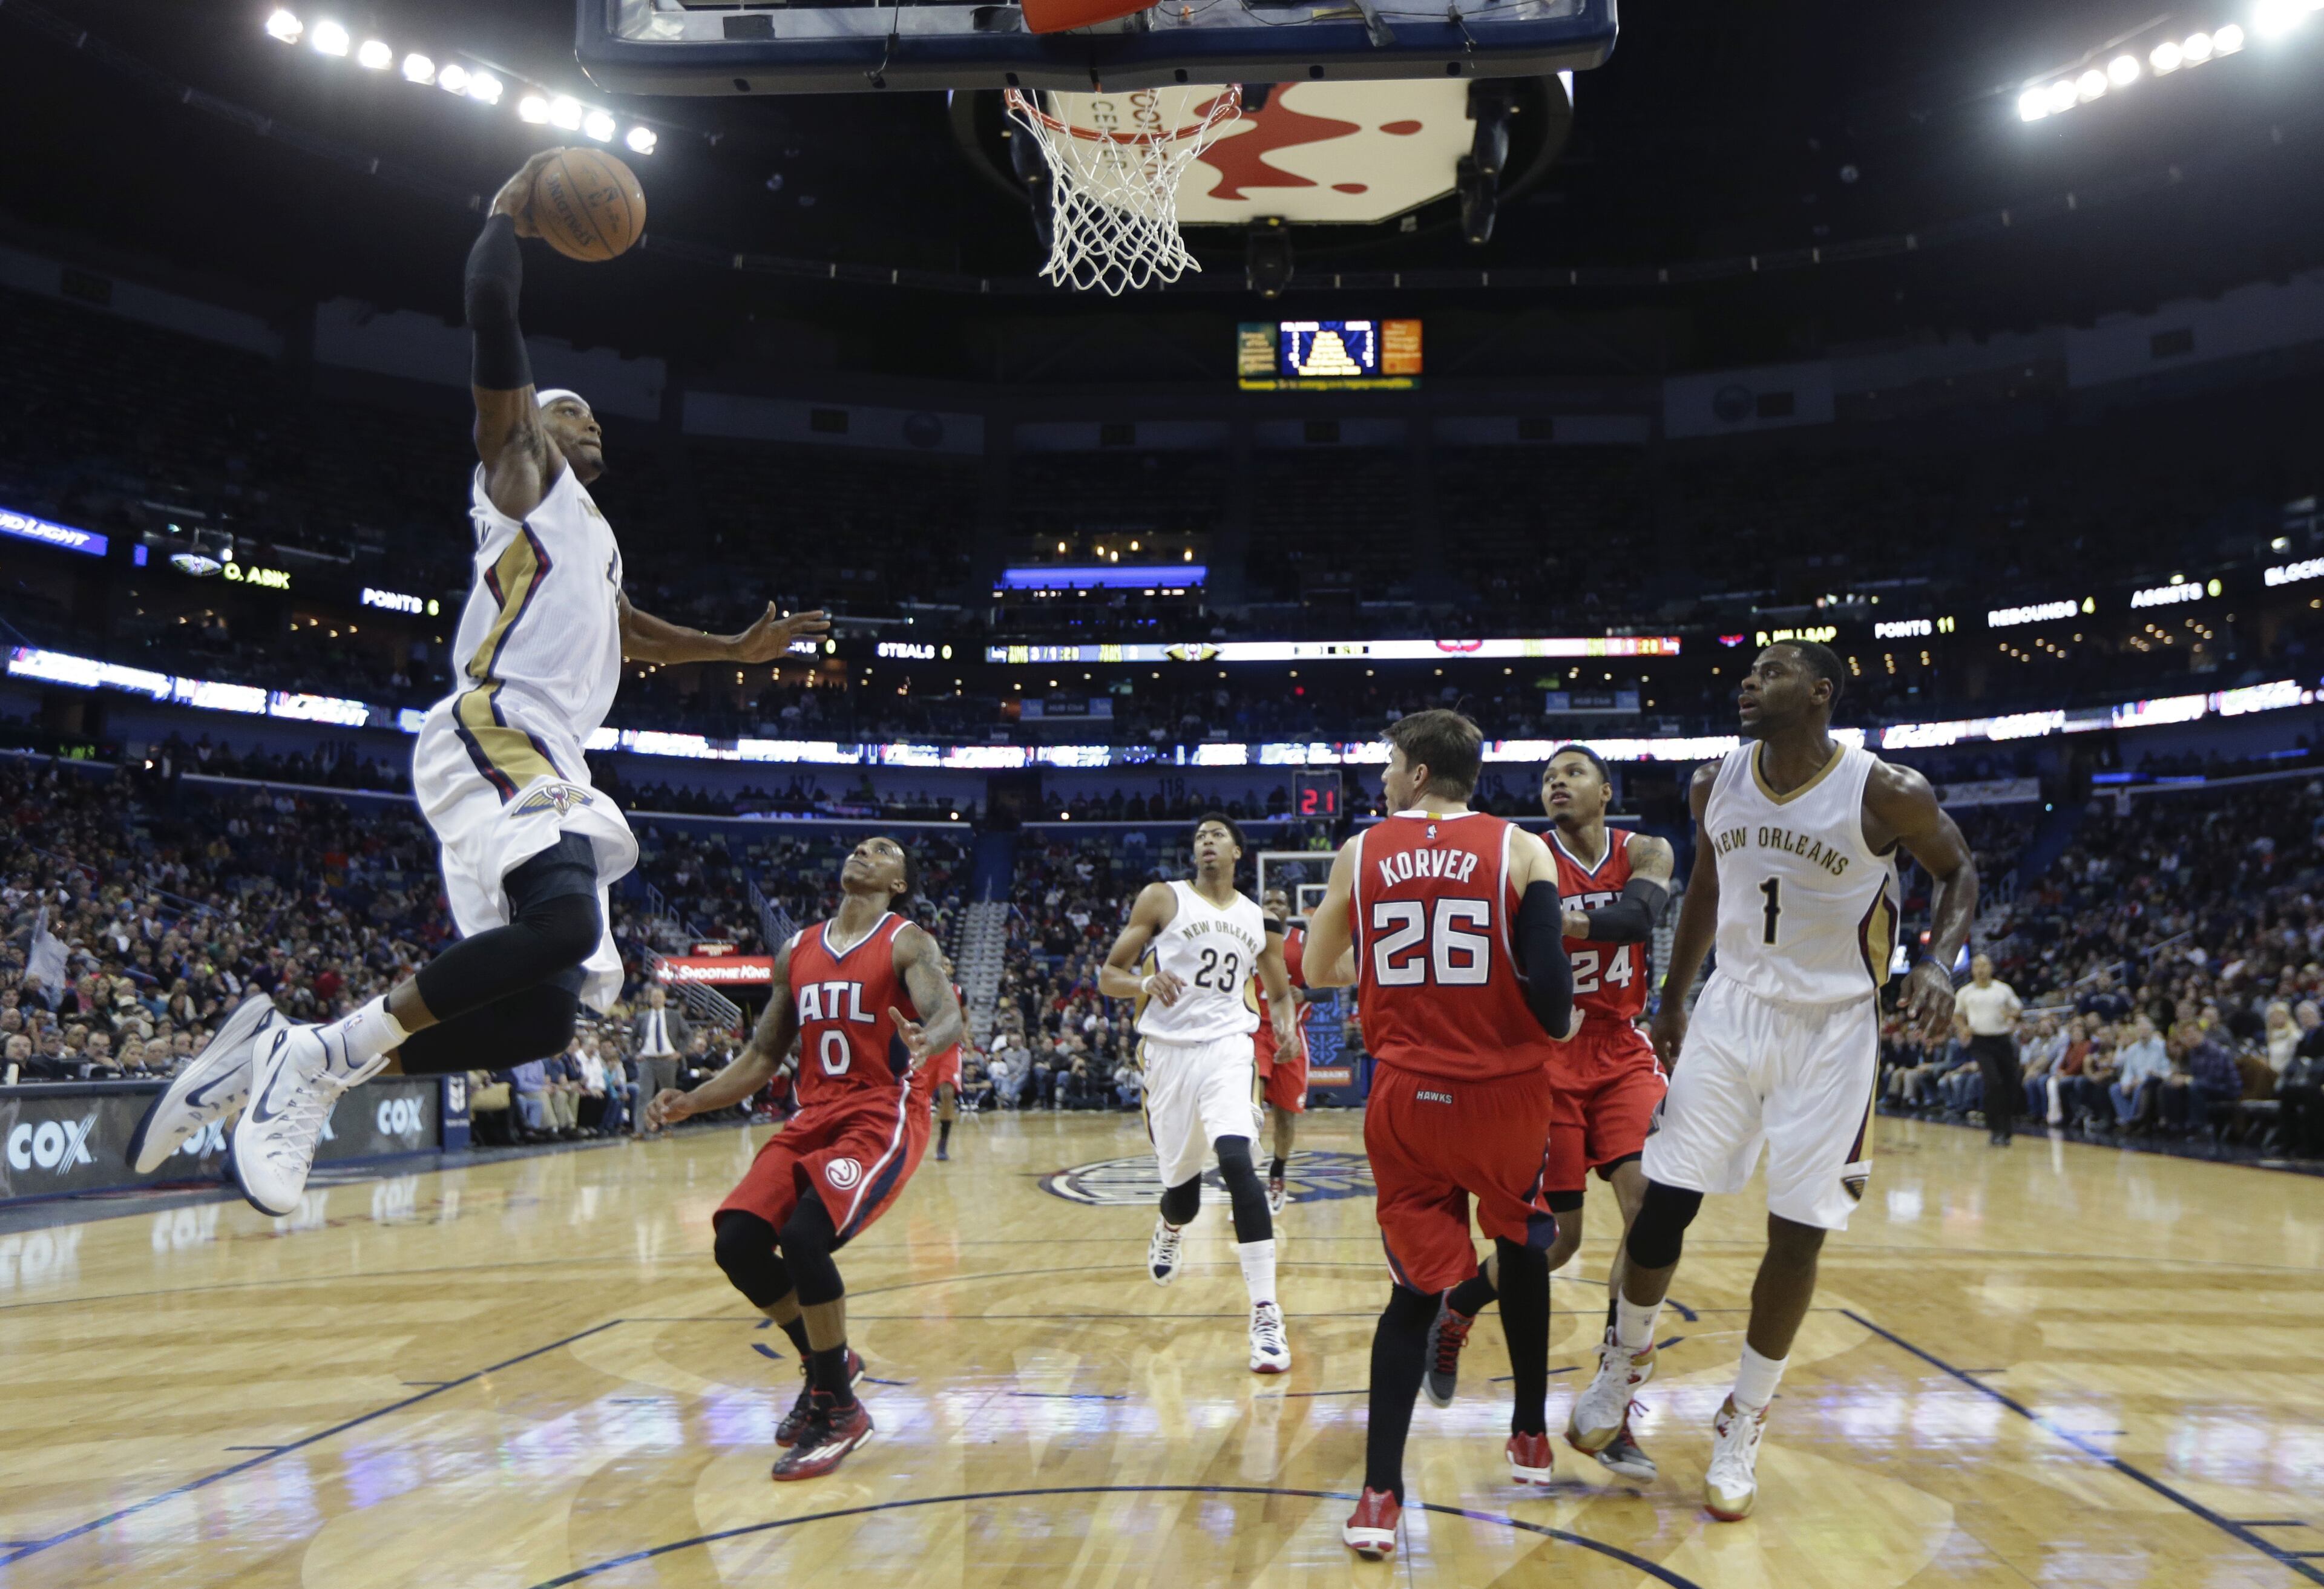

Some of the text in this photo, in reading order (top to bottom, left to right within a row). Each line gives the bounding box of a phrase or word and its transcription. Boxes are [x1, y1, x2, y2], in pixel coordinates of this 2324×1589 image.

[245, 566, 290, 590] ASIK
[363, 587, 423, 614] POINTS
[1988, 596, 2096, 628] REBOUNDS 4
[1874, 616, 1955, 639] POINTS 11
[878, 642, 952, 660] STEALS 0
[1301, 789, 1334, 815] 21
[1379, 848, 1478, 887] KORVER
[1715, 827, 1850, 876] NEW ORLEANS
[1759, 876, 1780, 945] 1
[1182, 920, 1258, 954] NEW ORLEANS
[1373, 898, 1490, 985] 26
[679, 964, 771, 980] SMOOTHIE KING
[1195, 948, 1238, 992] 23
[1571, 945, 1633, 994] 24
[799, 981, 875, 1026] ATL
[820, 1030, 851, 1075] 0
[378, 1095, 424, 1138] COX
[1416, 1090, 1452, 1104] HAWKS
[8, 1113, 99, 1176] COX
